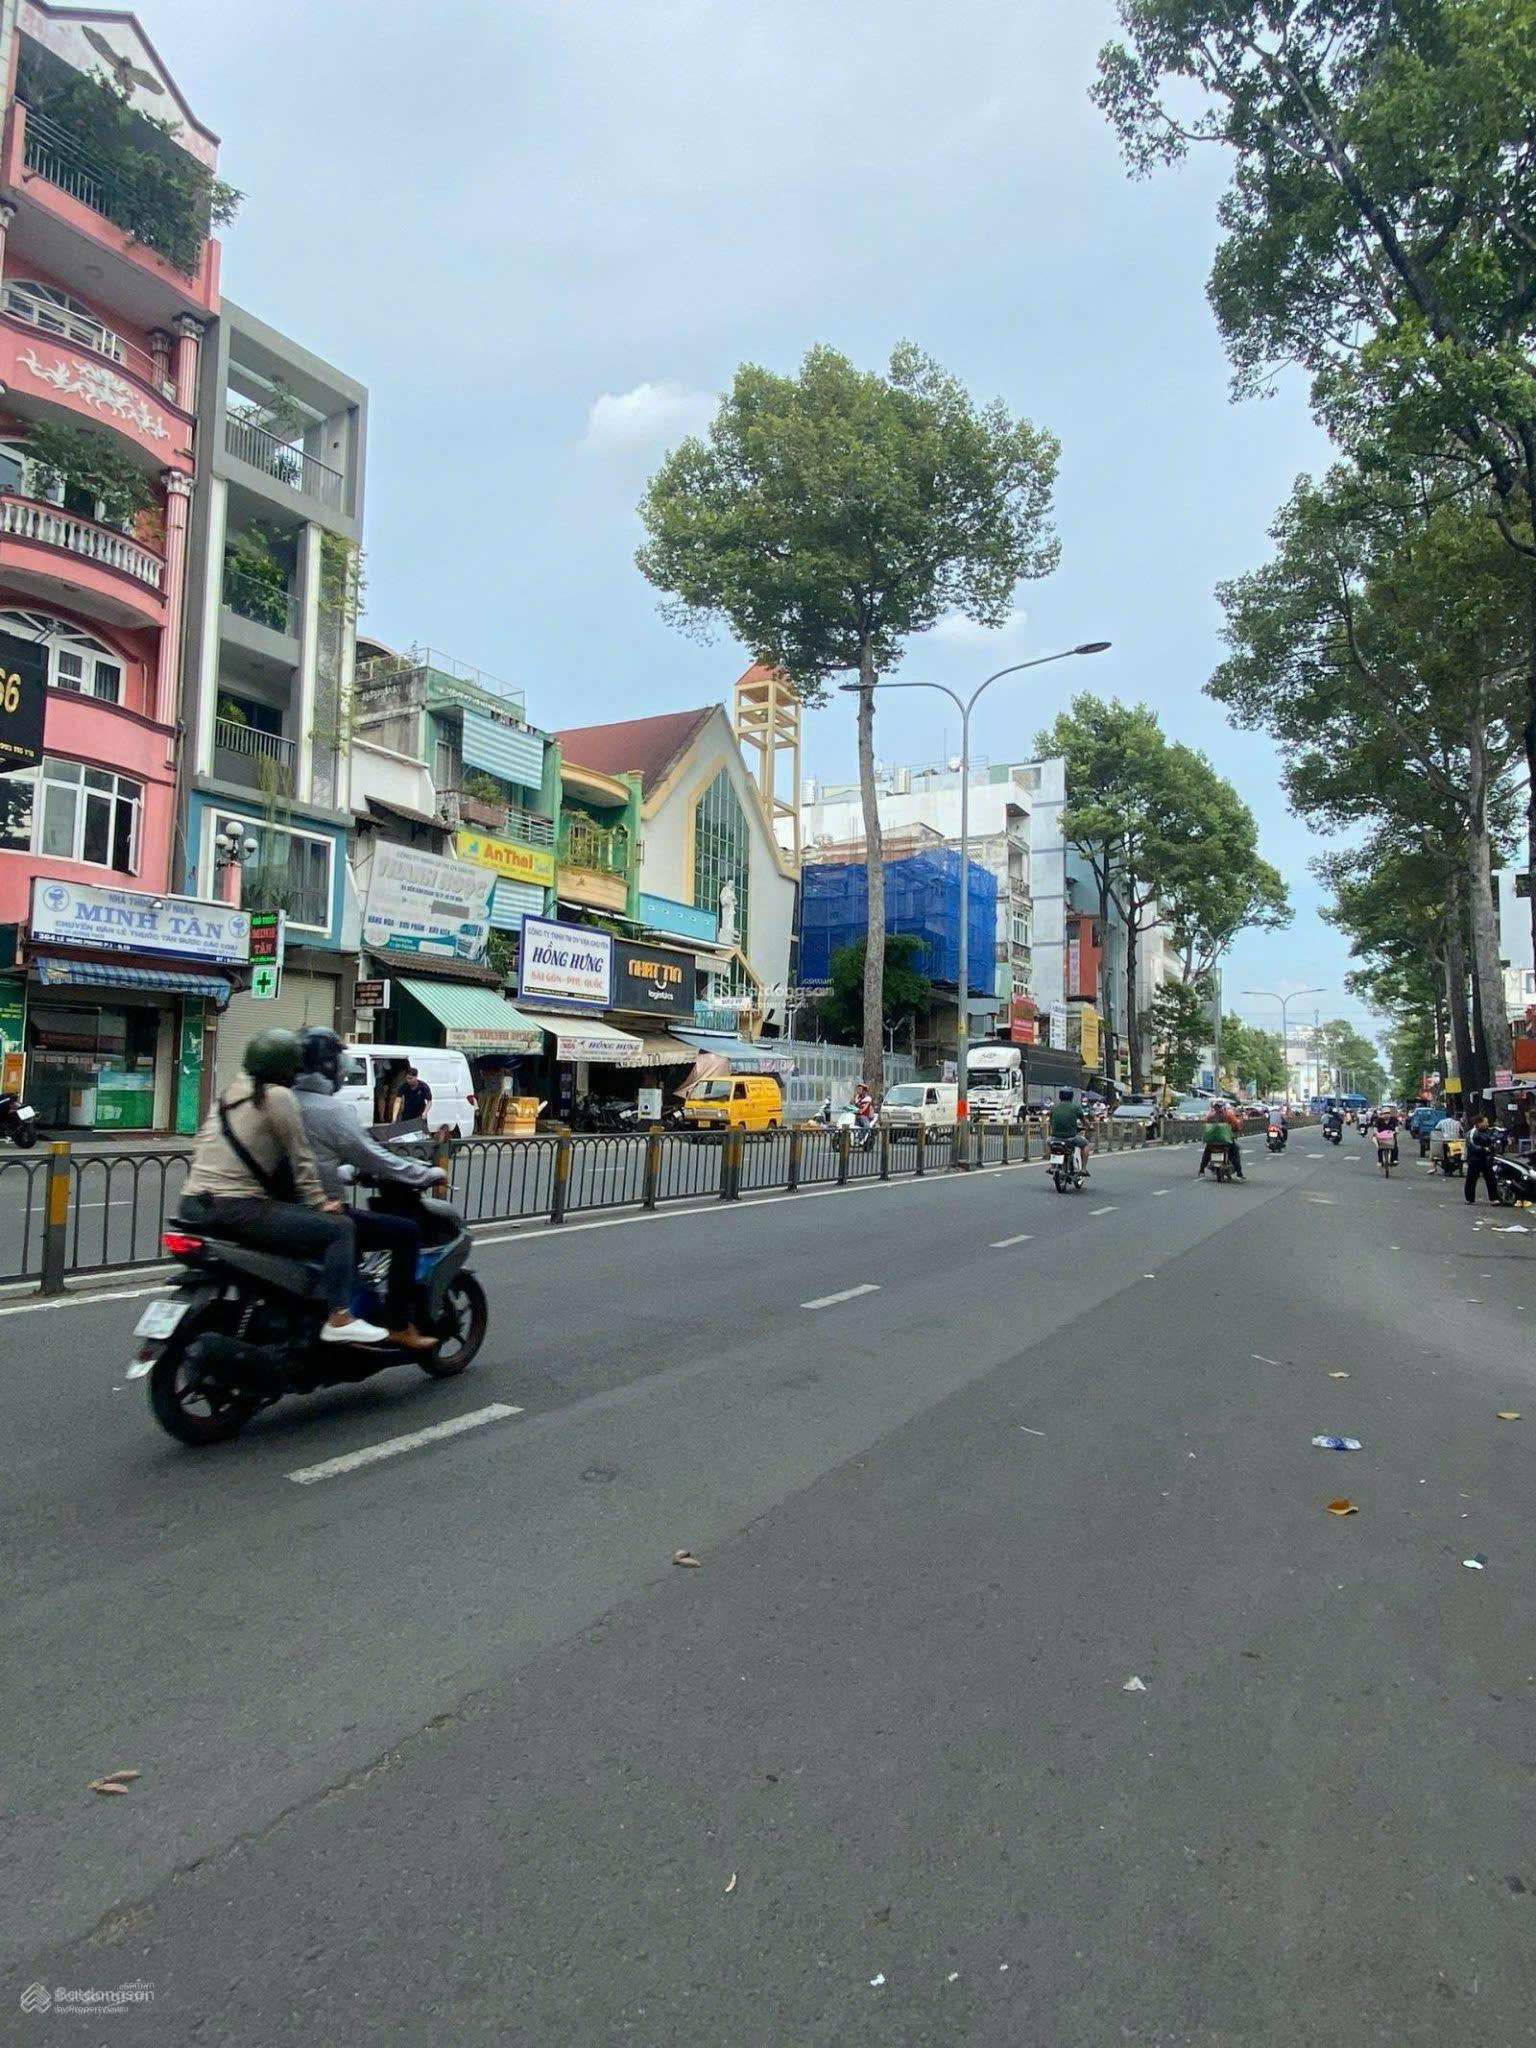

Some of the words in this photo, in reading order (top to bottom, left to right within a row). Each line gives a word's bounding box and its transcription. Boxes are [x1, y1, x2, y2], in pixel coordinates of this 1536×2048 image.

[74, 902, 159, 930] MINH
[168, 917, 224, 940] TÂN
[527, 926, 543, 937] CÔNG
[532, 941, 570, 968] HỒNG
[569, 952, 605, 973] HƯNG
[648, 988, 674, 1001] logistics
